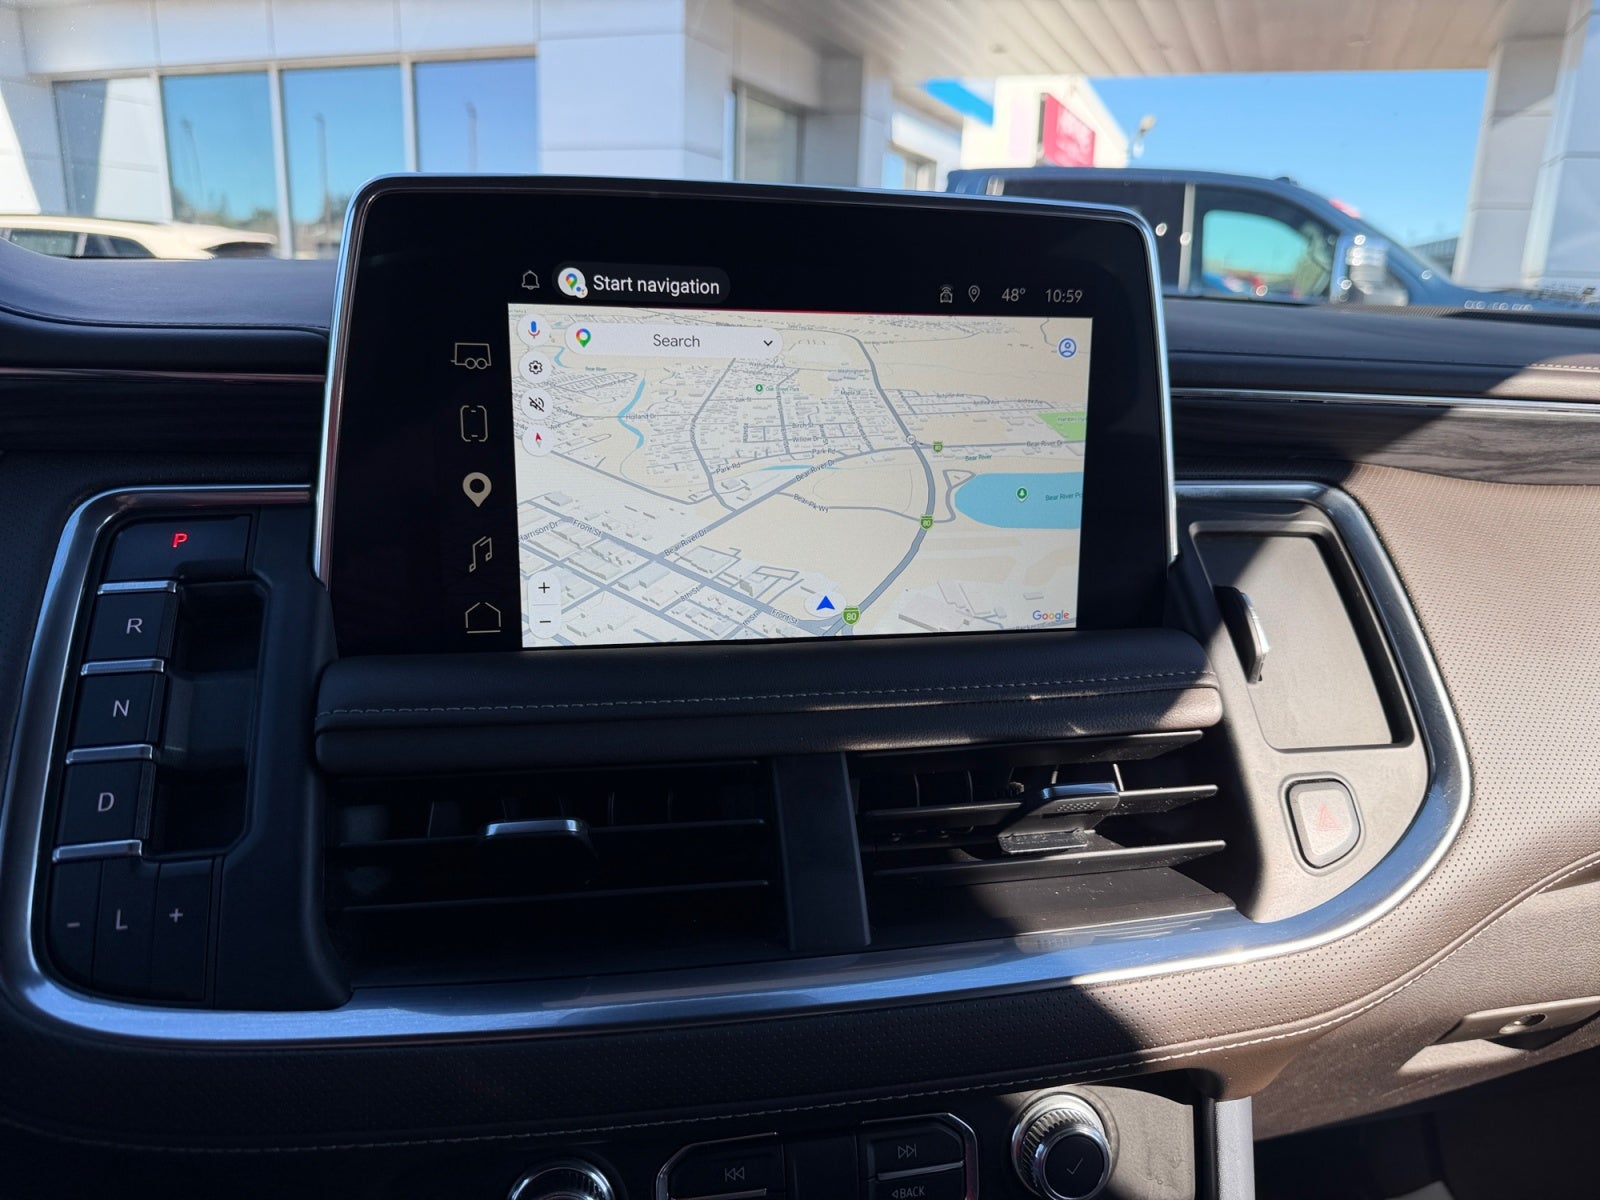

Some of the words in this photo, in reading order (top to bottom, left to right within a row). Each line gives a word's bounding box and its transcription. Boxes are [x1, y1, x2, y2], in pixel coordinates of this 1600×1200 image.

[593, 275, 633, 292] Start
[637, 278, 720, 297] navigation
[1045, 288, 1083, 303] 10:59
[653, 333, 701, 347] Search
[1026, 440, 1042, 448] Bear
[715, 465, 731, 475] Park
[796, 471, 810, 481] Bear
[810, 462, 827, 473] River
[518, 525, 549, 542] Harrison
[549, 521, 559, 530] Dr
[572, 519, 593, 533] Front
[593, 528, 602, 537] St
[172, 532, 189, 549] P
[664, 544, 681, 556] Bear
[680, 533, 699, 547] River
[771, 608, 790, 621] Front
[789, 616, 799, 625] St
[846, 612, 856, 621] 80
[1032, 609, 1070, 622] Google
[126, 618, 143, 634] R
[113, 700, 130, 717] N
[97, 792, 115, 812] D
[115, 909, 129, 930] L
[900, 1185, 925, 1199] BACK
